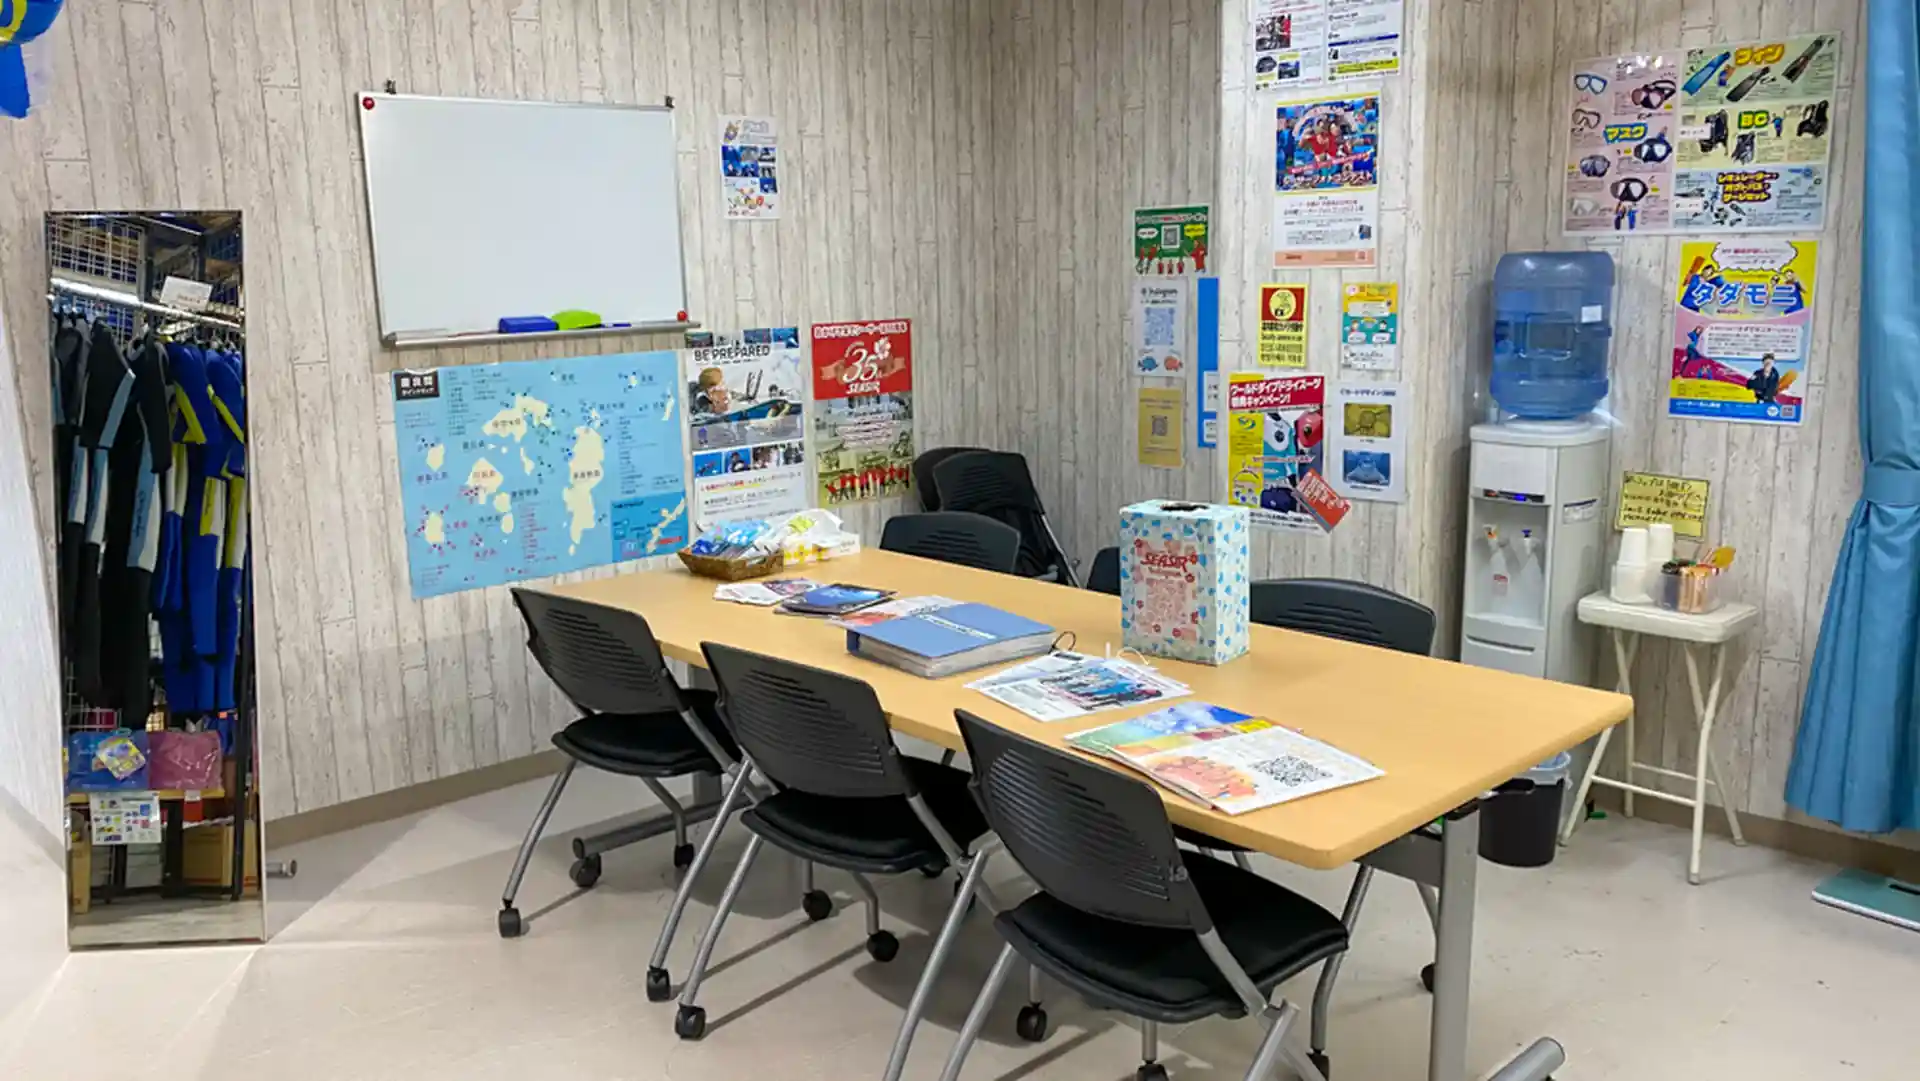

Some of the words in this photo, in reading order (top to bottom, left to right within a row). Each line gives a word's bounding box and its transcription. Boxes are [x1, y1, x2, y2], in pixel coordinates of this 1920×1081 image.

[1735, 43, 1785, 66] フィン
[1740, 111, 1768, 129] BC
[1605, 125, 1646, 141] マスク
[1692, 282, 1798, 308] タダモニ
[694, 348, 710, 362] BE
[711, 344, 771, 360] PREPARED
[842, 348, 878, 384] 35
